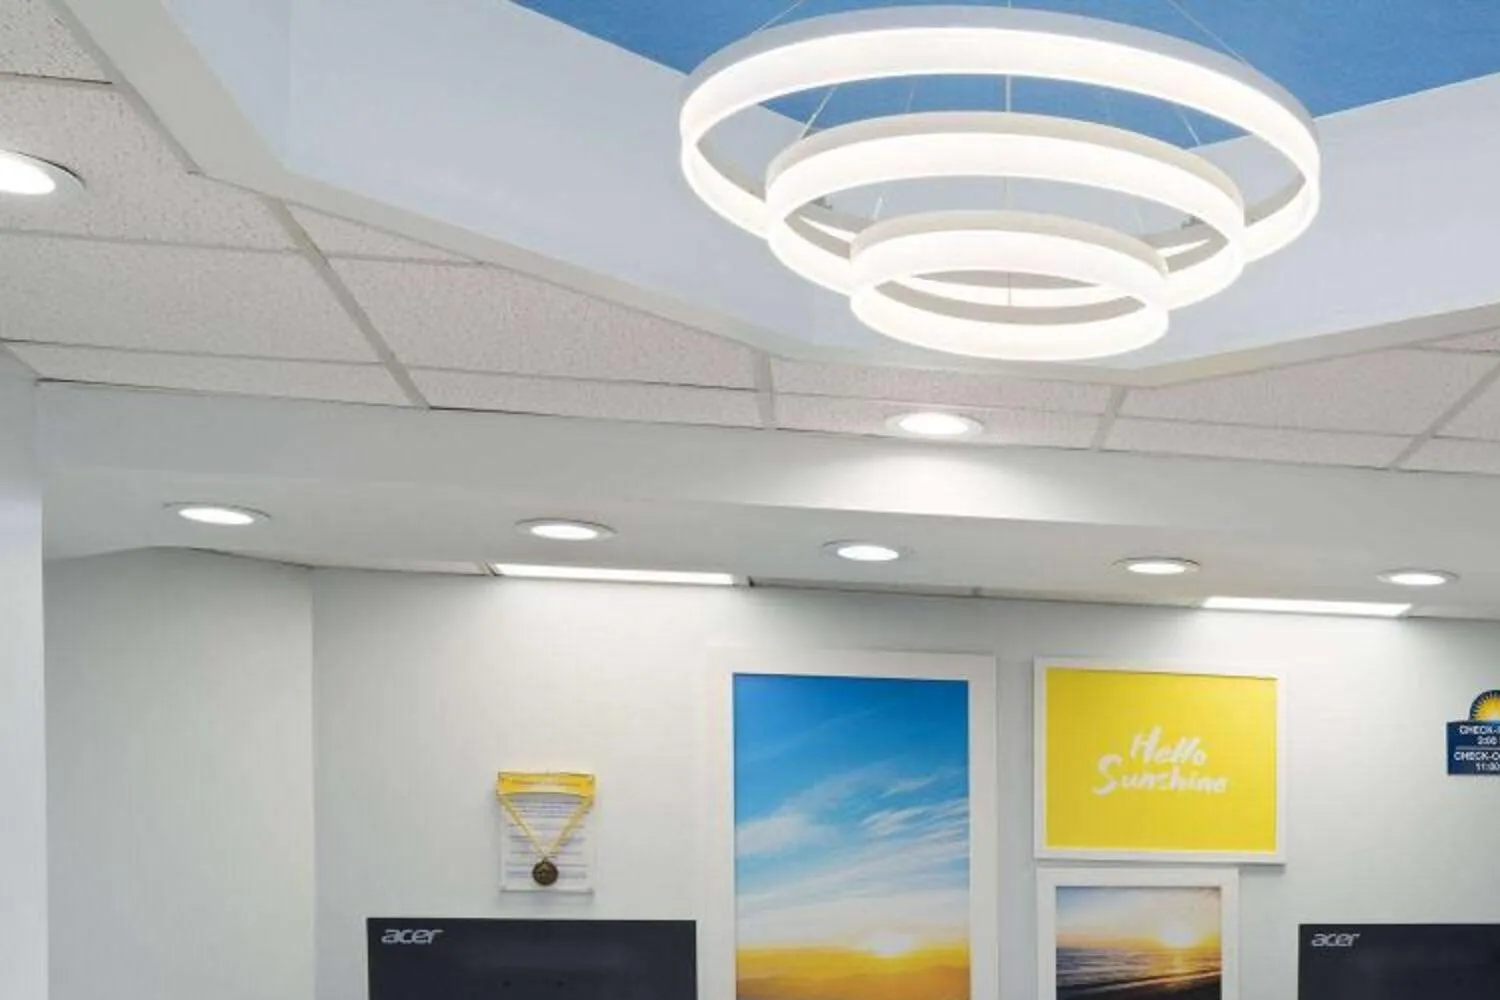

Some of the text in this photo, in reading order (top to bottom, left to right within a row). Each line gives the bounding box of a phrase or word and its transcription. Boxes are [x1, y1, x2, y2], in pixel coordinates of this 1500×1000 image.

[1129, 725, 1206, 765] Hello
[1091, 754, 1228, 796] Sunshine
[381, 929, 444, 944] acer
[1311, 933, 1360, 947] acer
